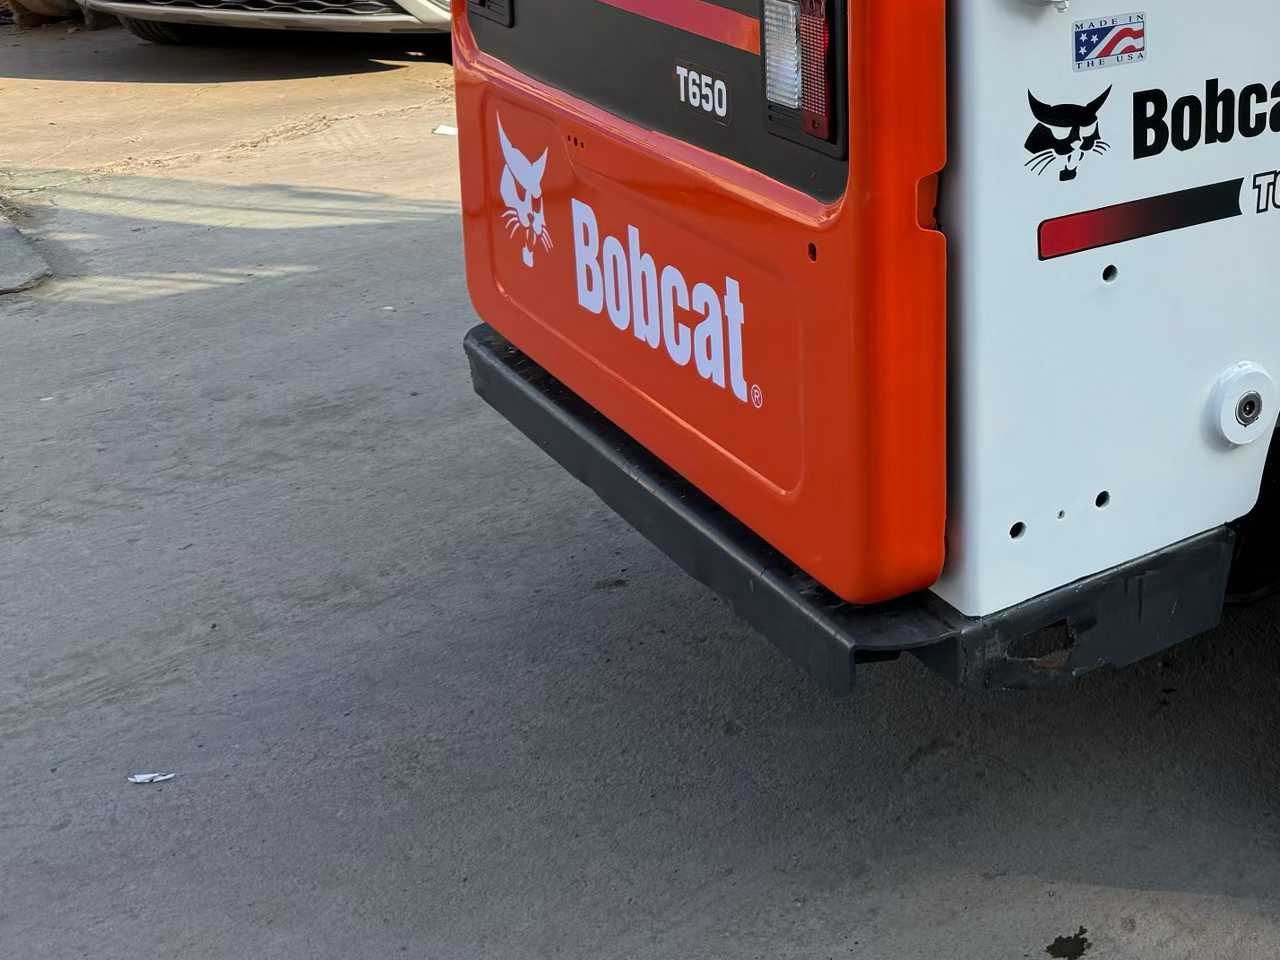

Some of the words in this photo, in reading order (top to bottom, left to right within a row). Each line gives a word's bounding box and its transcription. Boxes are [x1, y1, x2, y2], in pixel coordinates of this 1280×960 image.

[1075, 18, 1118, 30] MADE
[1128, 14, 1144, 22] IN
[1075, 59, 1105, 69] THE
[1116, 53, 1144, 62] USA
[676, 65, 727, 117] T650
